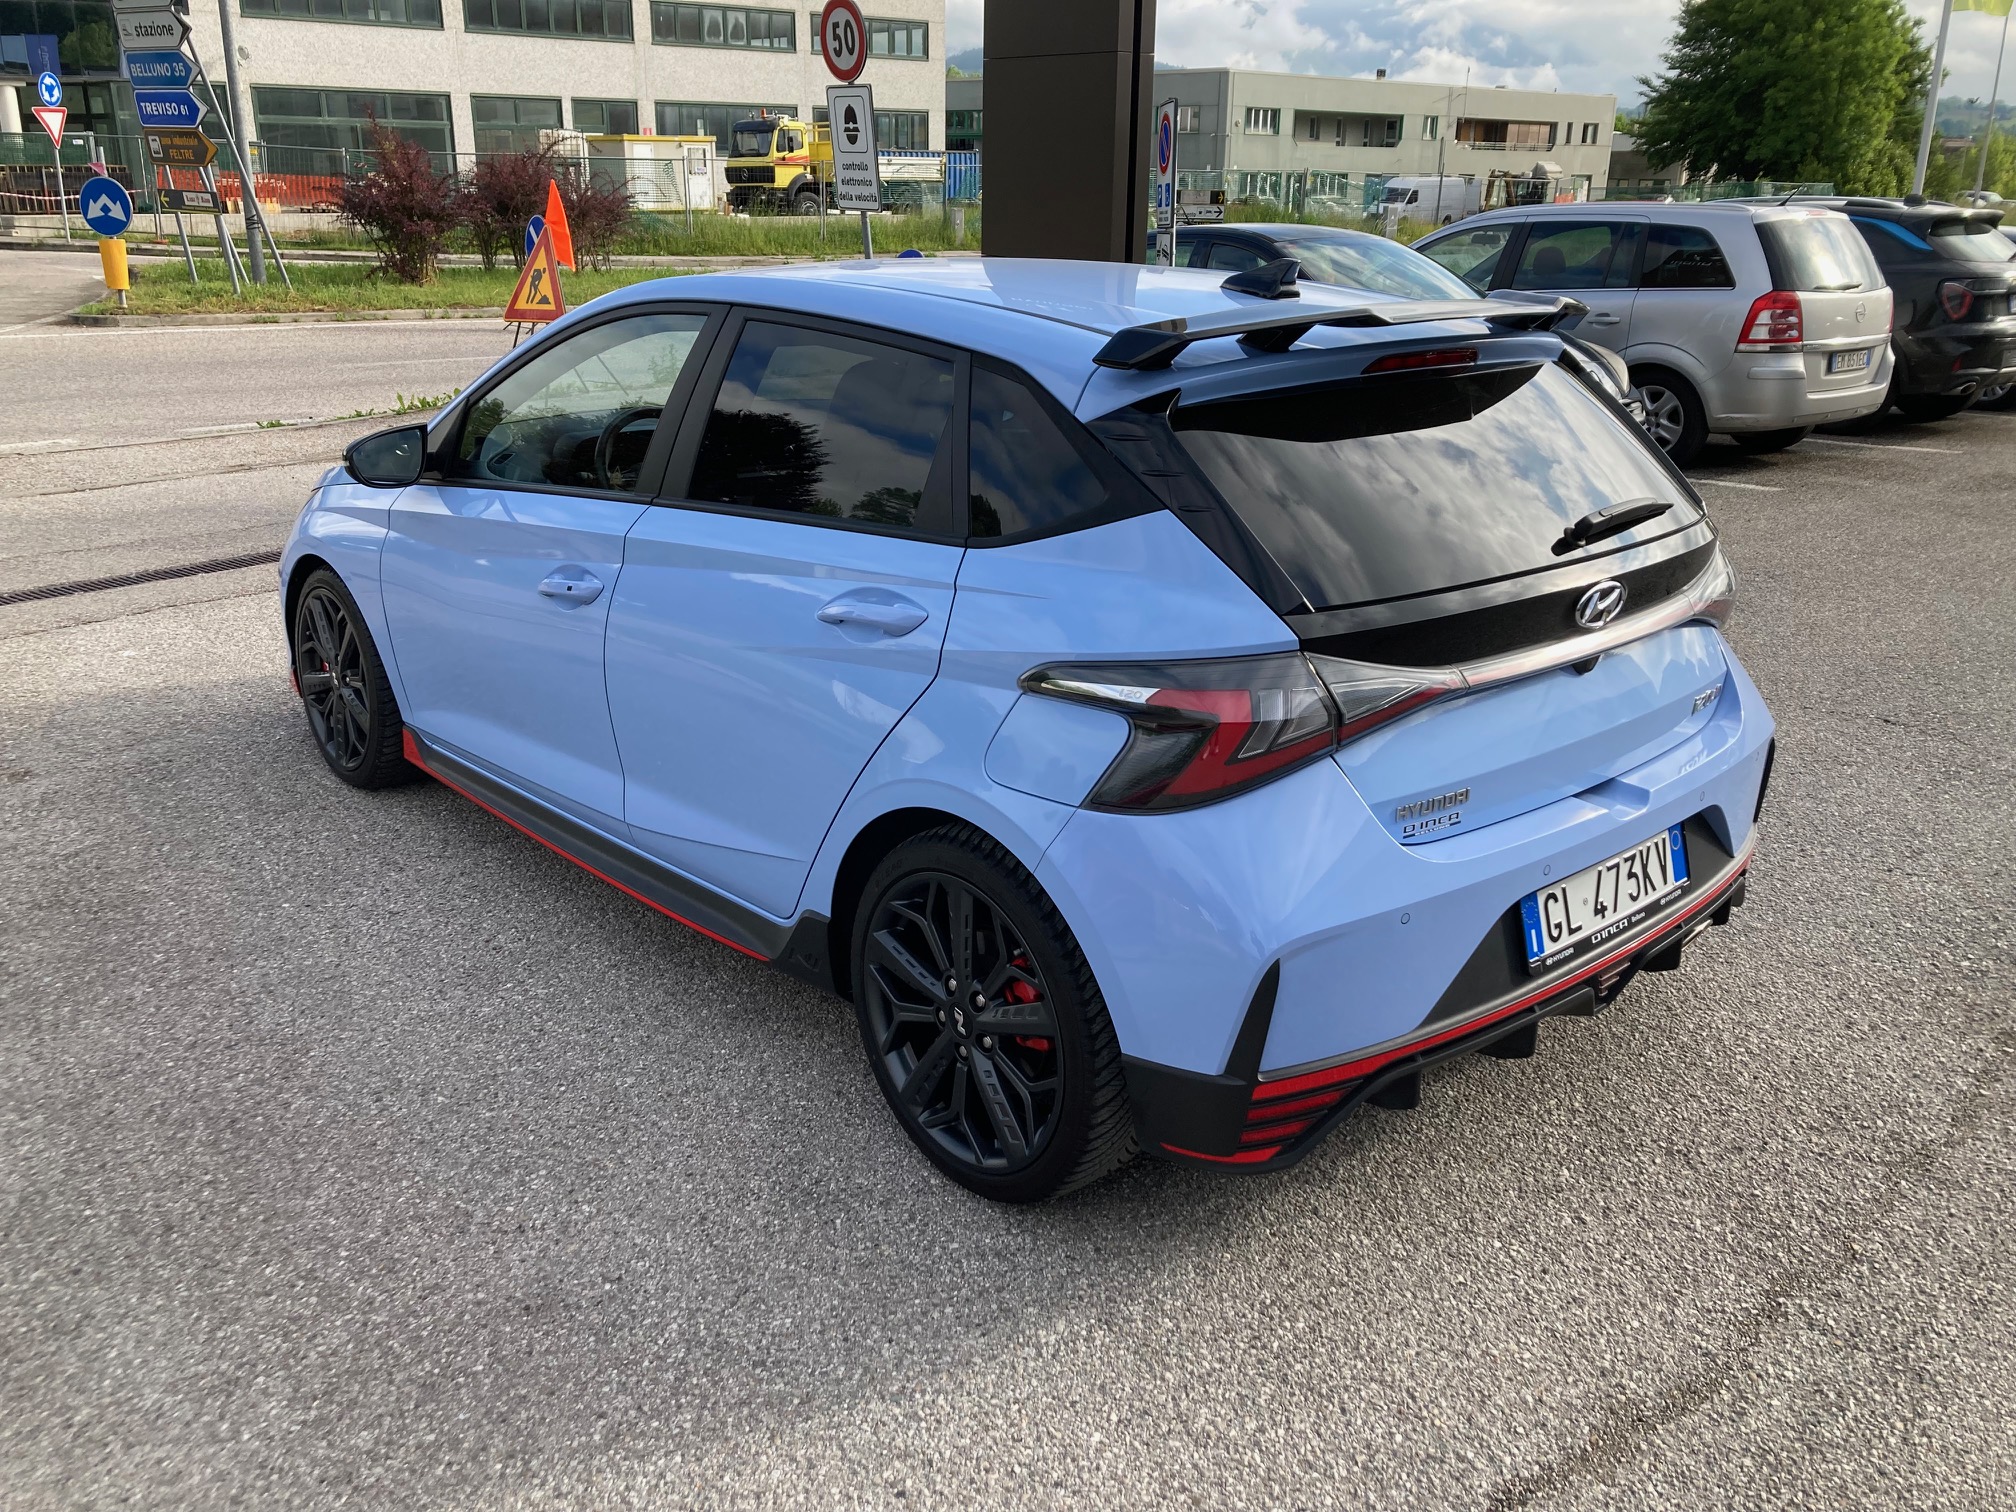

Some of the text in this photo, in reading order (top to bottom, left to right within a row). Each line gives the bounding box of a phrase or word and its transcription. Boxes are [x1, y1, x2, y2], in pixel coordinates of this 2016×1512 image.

[134, 21, 174, 37] stazione
[831, 18, 856, 58] 50
[130, 63, 186, 77] BELLUNO 35
[140, 102, 189, 116] TREVISO 61
[169, 149, 195, 160] FELTRE
[842, 162, 869, 172] controllo
[841, 177, 873, 188] elettronico
[839, 191, 878, 203] della velocità
[1395, 787, 1471, 823] HYUNDAI
[1544, 884, 1584, 943] GL
[1593, 834, 1668, 920] 473KV
[1665, 889, 1682, 903] HYUNDAI
[1552, 947, 1575, 962] HYUNDAI
